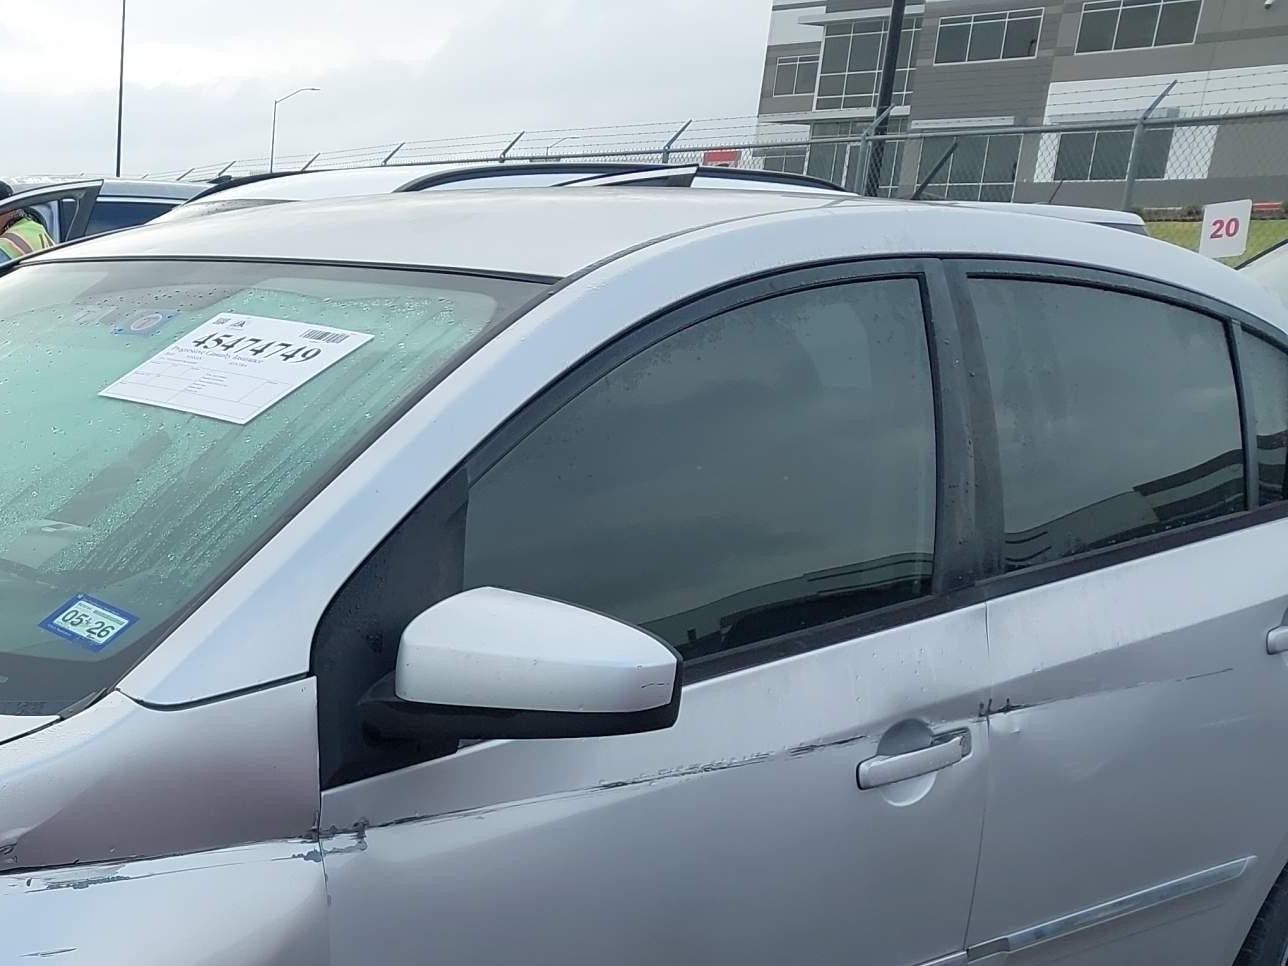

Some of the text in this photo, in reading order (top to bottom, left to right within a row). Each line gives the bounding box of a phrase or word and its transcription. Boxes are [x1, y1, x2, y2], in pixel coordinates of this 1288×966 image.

[1210, 217, 1240, 239] 20
[191, 332, 322, 364] 45474749
[61, 609, 89, 627] 05
[86, 620, 115, 639] 26
